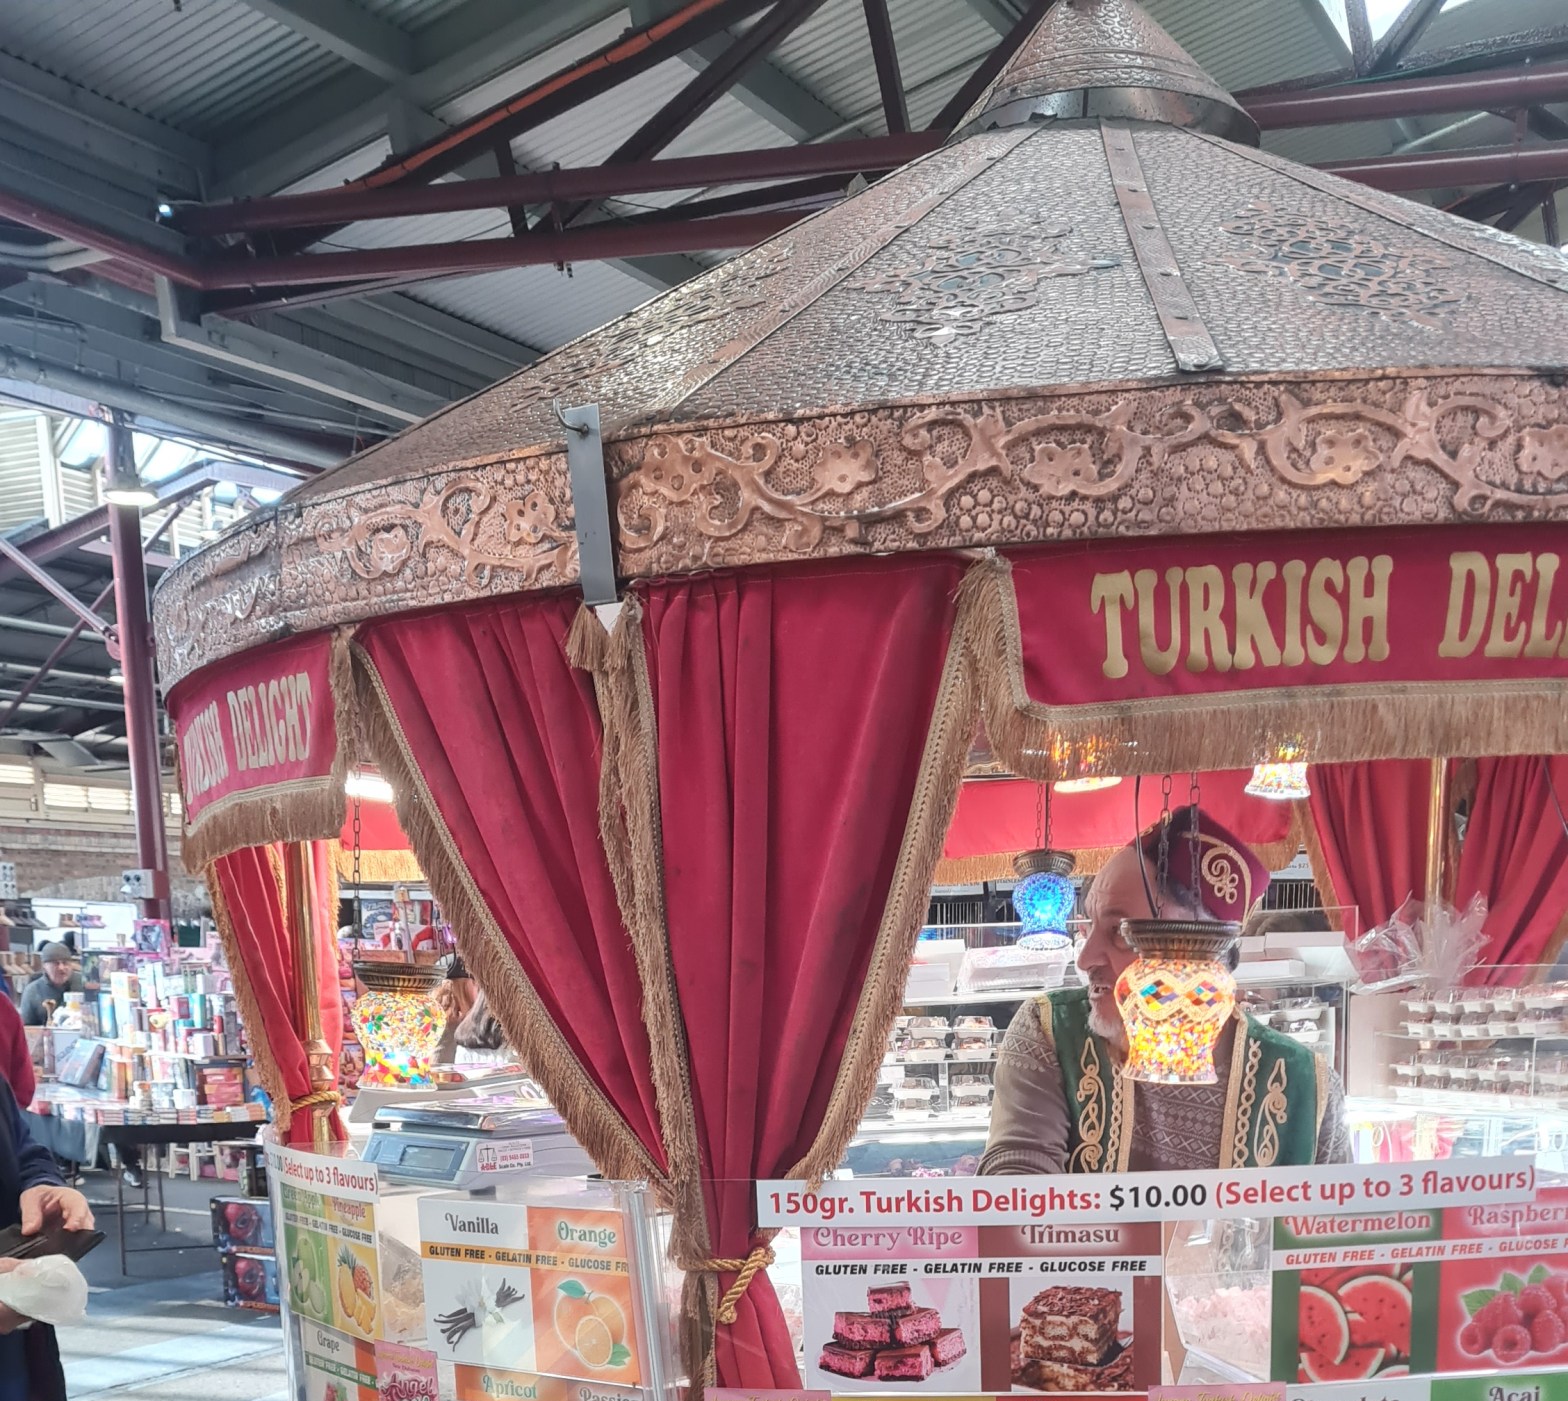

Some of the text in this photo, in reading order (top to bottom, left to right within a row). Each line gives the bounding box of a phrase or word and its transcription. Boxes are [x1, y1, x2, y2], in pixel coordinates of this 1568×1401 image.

[1090, 554, 1393, 678] TURKISH
[227, 670, 312, 771] DELIGHT
[304, 1166, 313, 1185] up
[315, 1165, 324, 1183] to
[326, 1167, 332, 1184] 3
[333, 1166, 379, 1195] flavours)
[770, 1165, 1535, 1219] 150gr. Turkish Delights: $10.00 (Select up to 3 flavours)
[342, 1227, 361, 1241] GLUCOSE
[361, 1233, 372, 1244] FREE
[445, 1212, 499, 1235] Vanilla
[558, 1221, 617, 1248] Orange
[1021, 1224, 1120, 1244] Trimasu
[1284, 1211, 1431, 1236] Watermelon
[813, 1225, 962, 1251] Cherry Ripe
[429, 1245, 461, 1257] GLUTEN
[464, 1248, 485, 1259] FREE
[495, 1251, 532, 1264] GELATIN
[535, 1254, 558, 1266] FREE
[568, 1257, 611, 1271] GLUCOSE
[1286, 1252, 1337, 1265] GLUTEN
[1342, 1250, 1375, 1262] FREE
[1391, 1246, 1446, 1259] GELATIN
[1451, 1243, 1483, 1255] FREE
[1499, 1239, 1558, 1252] GLUCOSE
[815, 1264, 868, 1275] GLUTEN
[873, 1263, 907, 1275] FREE
[924, 1262, 982, 1274] GELATIN
[988, 1262, 1023, 1273] FREE
[1040, 1261, 1105, 1272] GLUCOSE
[1112, 1260, 1147, 1271] FREE
[317, 1330, 340, 1353] Grape
[482, 1375, 537, 1399] Apricot
